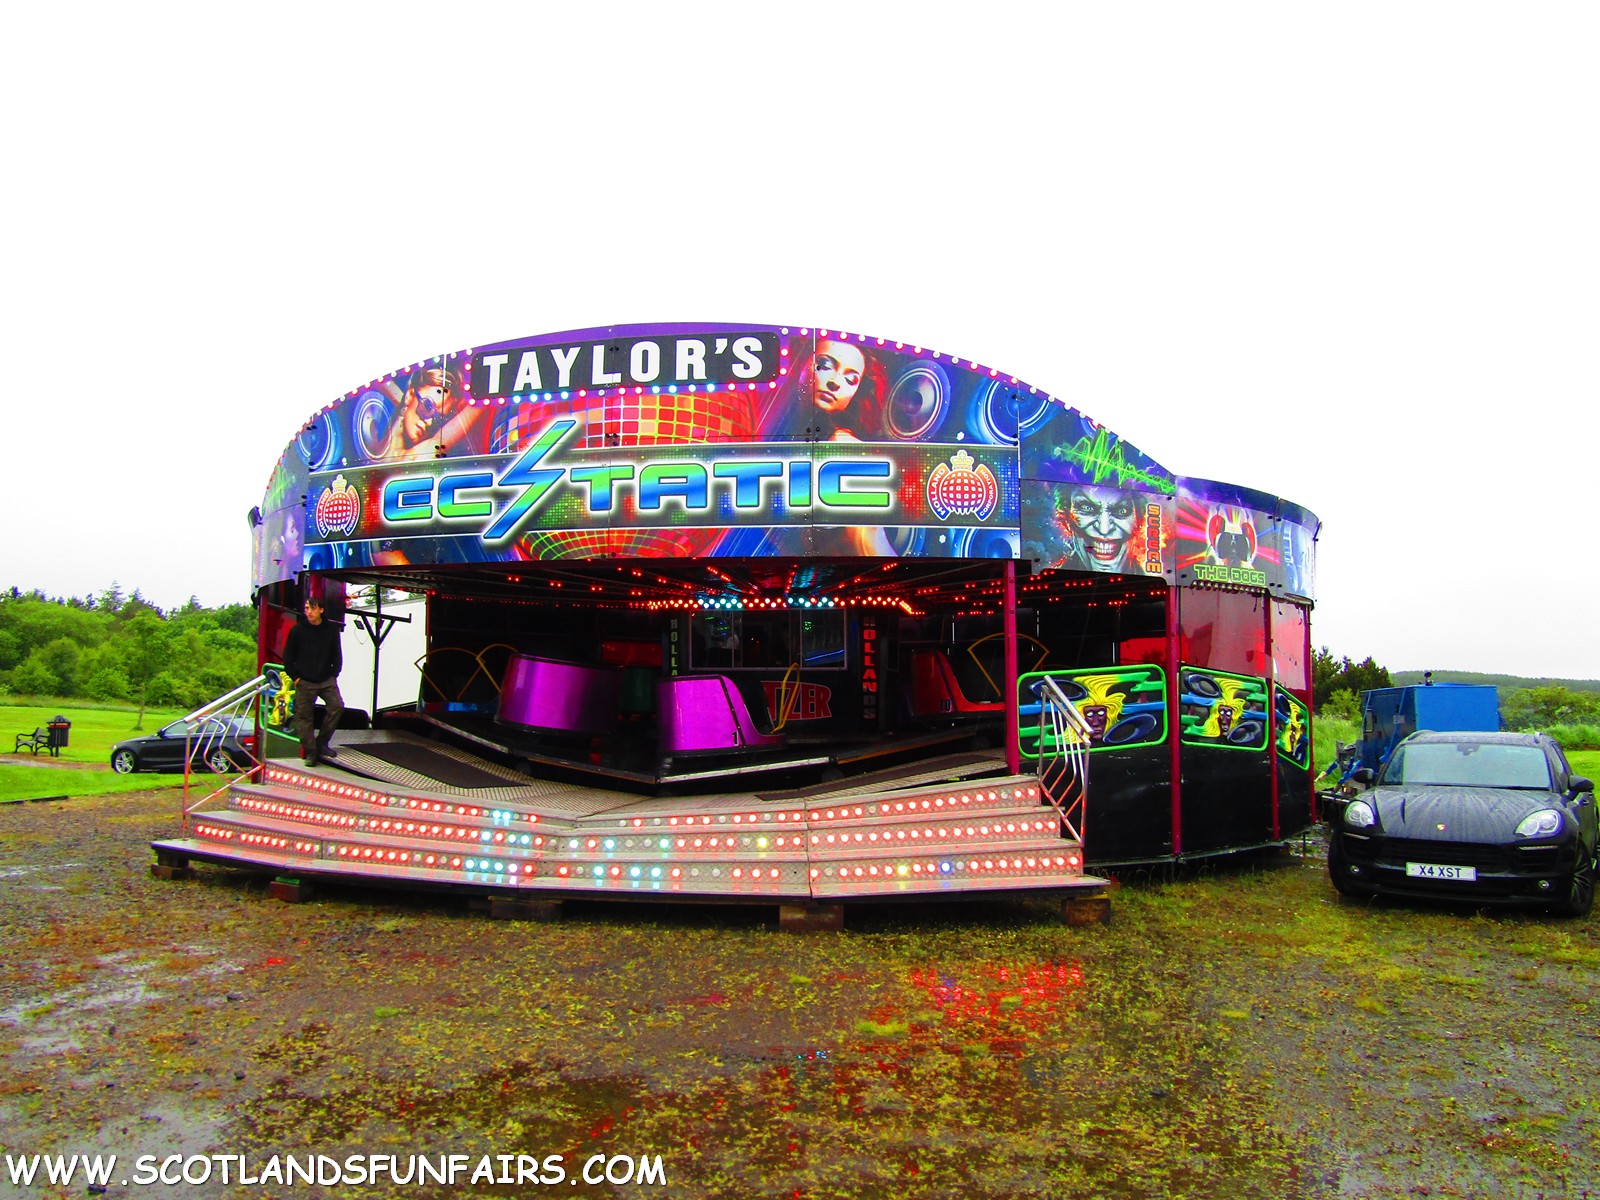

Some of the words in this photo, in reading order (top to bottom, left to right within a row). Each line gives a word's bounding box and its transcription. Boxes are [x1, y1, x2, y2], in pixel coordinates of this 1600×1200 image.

[482, 336, 763, 394] TAYLOR'S
[318, 491, 330, 534] HOLLAND
[930, 467, 946, 516] HOLLAND
[979, 469, 994, 517] CORPORATION
[1146, 503, 1162, 575] SCREAM
[1194, 564, 1228, 582] THE
[1231, 567, 1266, 586] DOGS
[670, 618, 679, 676] HOLLA
[862, 616, 878, 720] HOLLANDS
[1419, 865, 1434, 877] X4
[1438, 867, 1461, 879] XST
